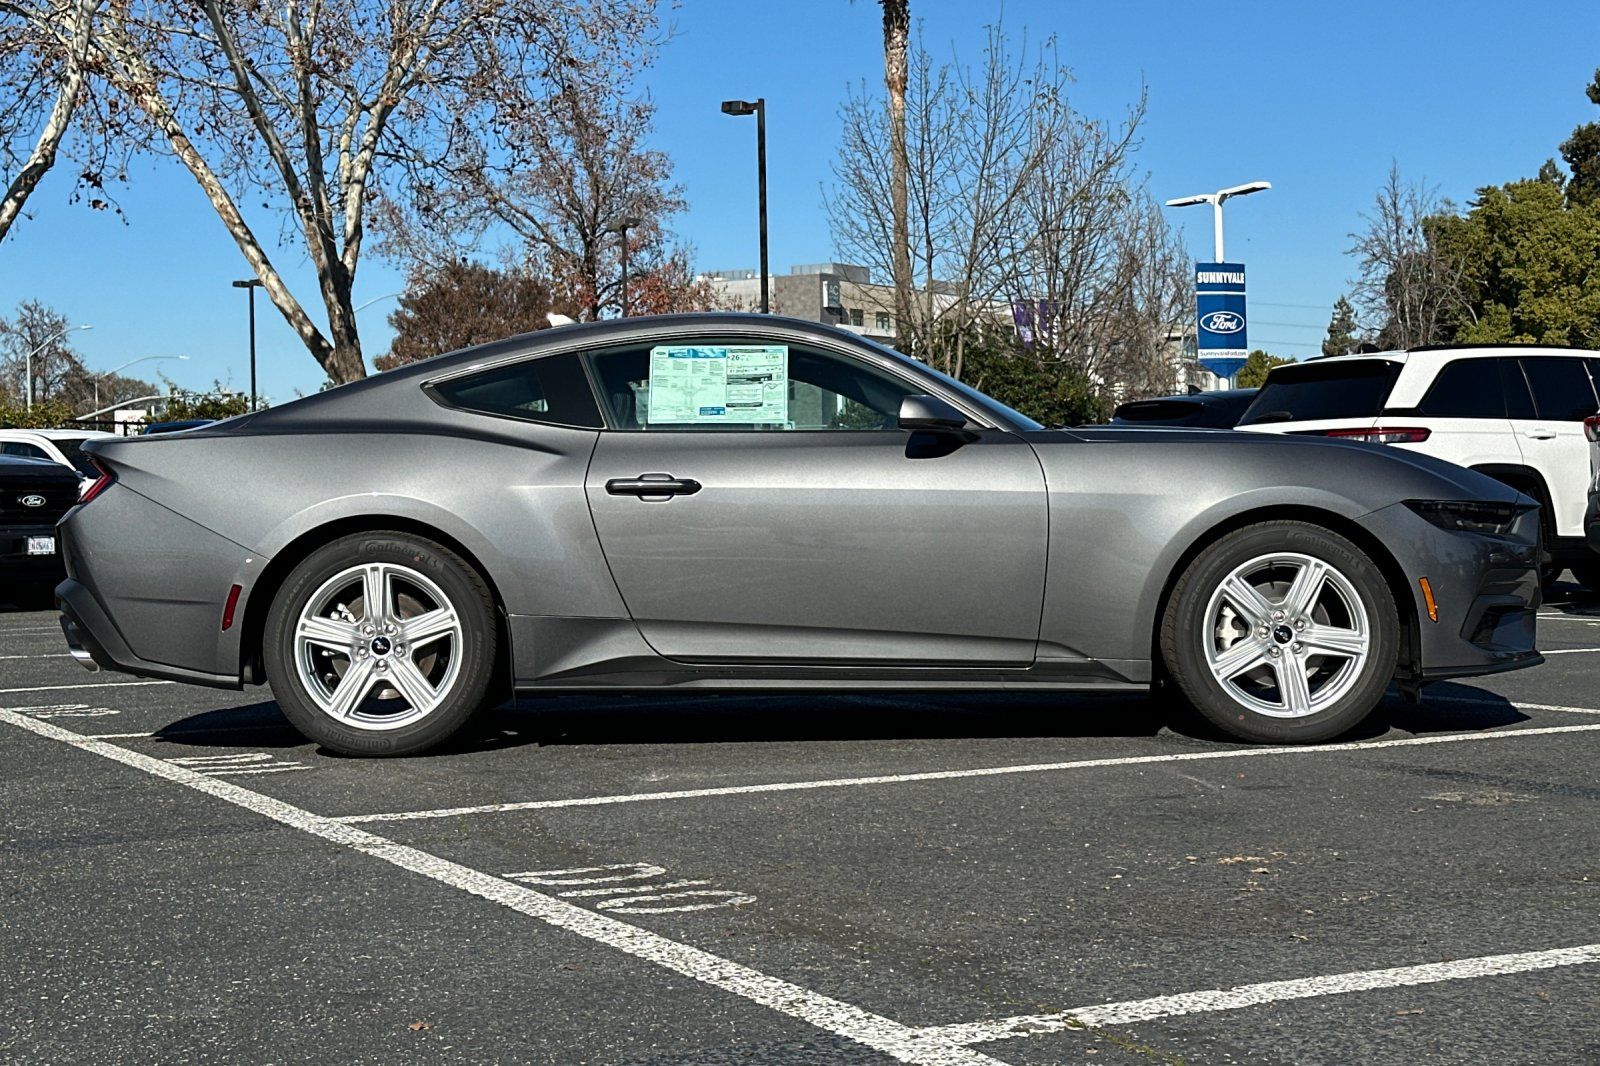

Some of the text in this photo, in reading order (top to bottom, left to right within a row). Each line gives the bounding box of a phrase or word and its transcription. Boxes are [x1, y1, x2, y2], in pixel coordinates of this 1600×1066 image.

[1197, 272, 1245, 284] SUNNYVALE
[1210, 314, 1238, 330] Ford
[27, 496, 42, 505] Ford
[365, 542, 431, 562] Continental
[1293, 531, 1355, 563] Continental
[327, 729, 392, 750] Continental
